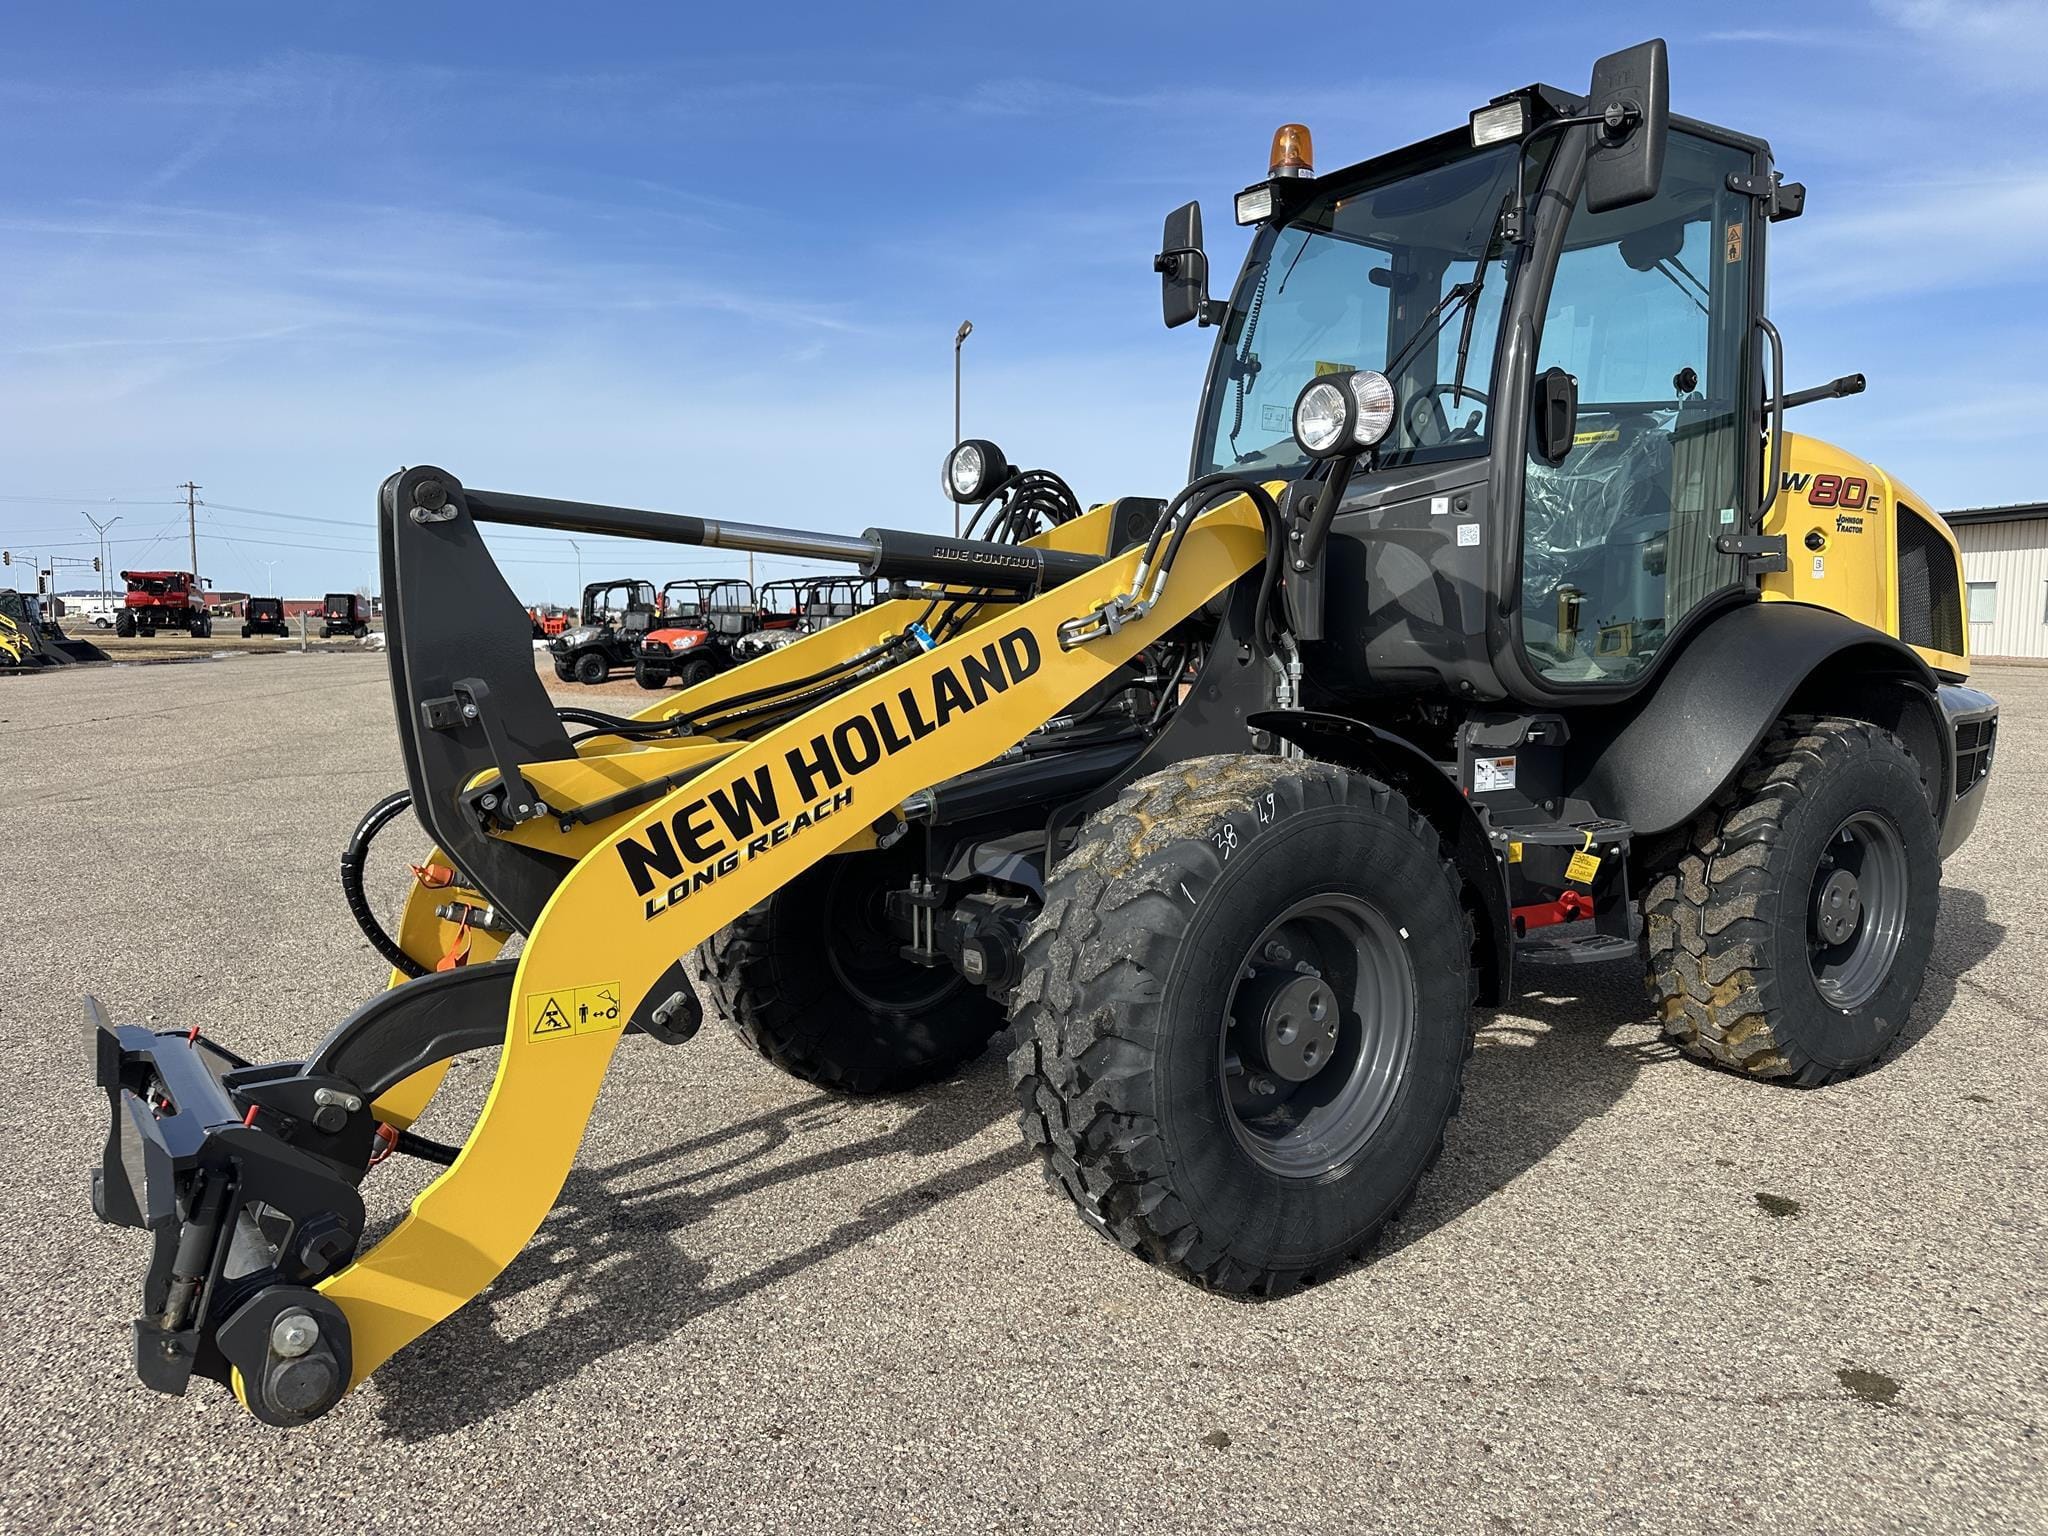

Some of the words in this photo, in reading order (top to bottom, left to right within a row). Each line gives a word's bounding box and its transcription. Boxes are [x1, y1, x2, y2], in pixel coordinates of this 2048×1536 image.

[1835, 514, 1864, 525] JOHNSON
[1836, 523, 1864, 535] TRACTOR
[932, 546, 969, 562] RIDE
[972, 551, 1038, 570] CONTROL
[615, 764, 781, 897] NEW
[784, 626, 1042, 803] HOLLAND
[643, 849, 741, 921] LONG
[746, 786, 855, 863] REACH
